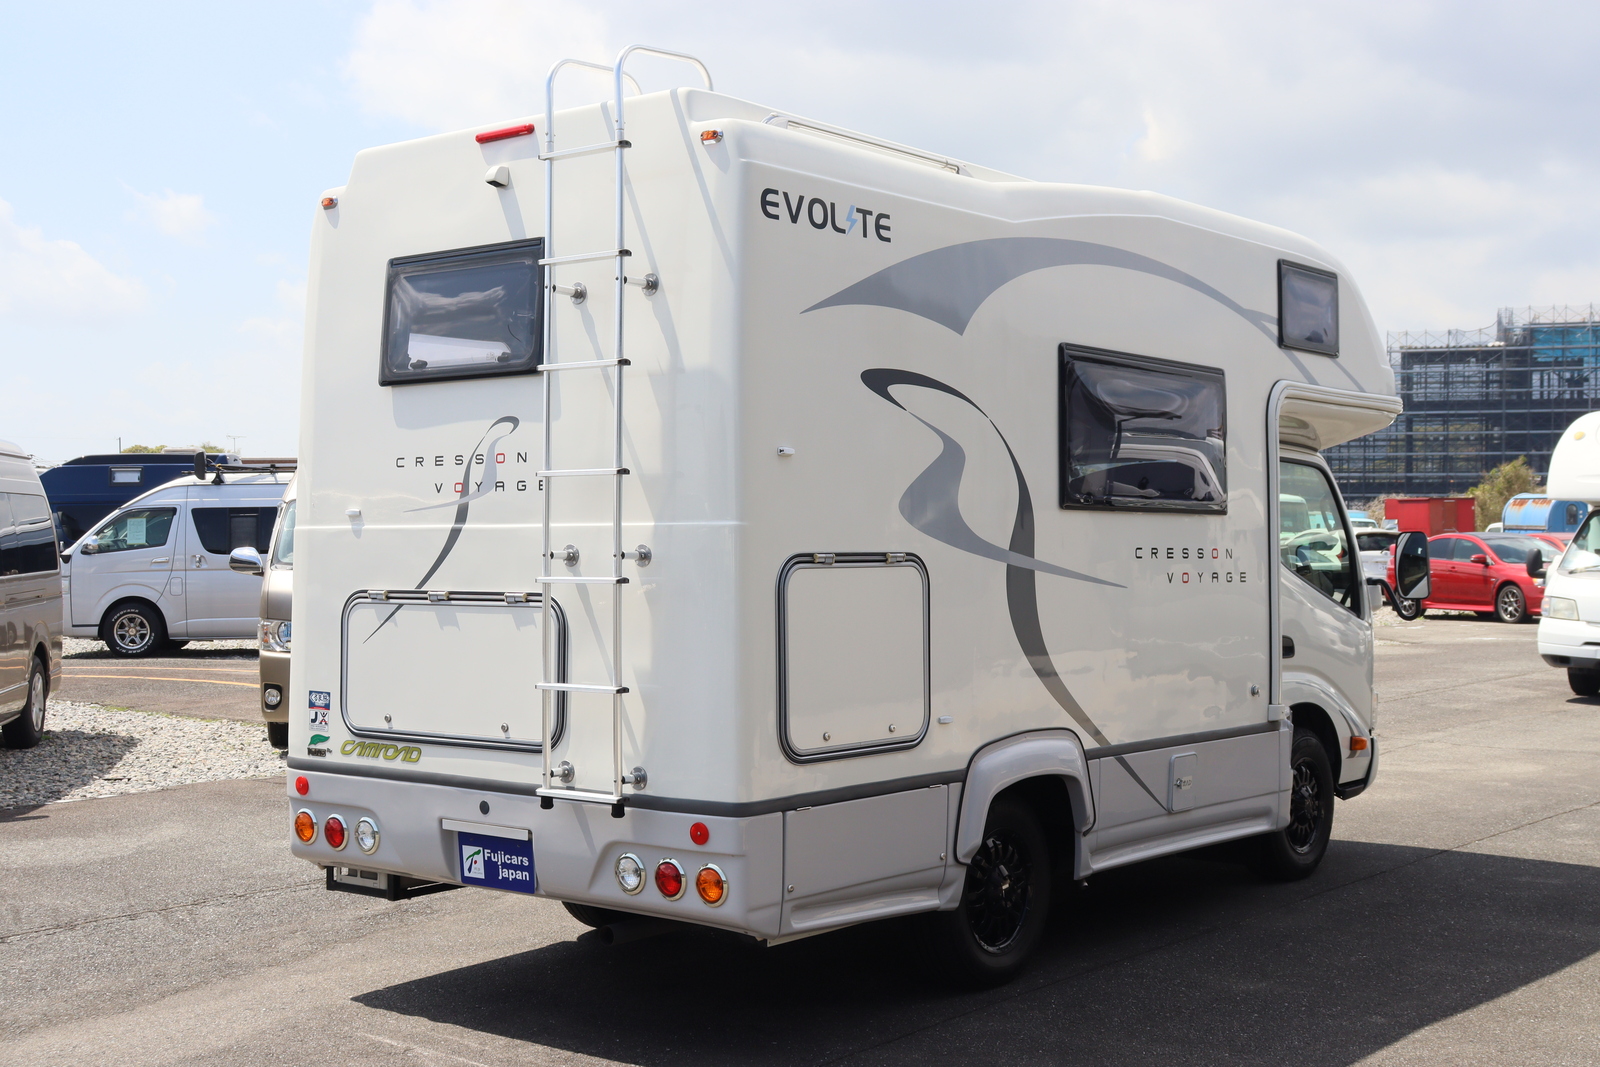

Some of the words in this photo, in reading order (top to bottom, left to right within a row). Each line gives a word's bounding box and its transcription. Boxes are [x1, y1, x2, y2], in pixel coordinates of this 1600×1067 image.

[395, 451, 528, 469] CRESSON
[1134, 547, 1233, 560] CRESSON
[1166, 571, 1247, 584] VOYAGE
[484, 849, 529, 867] Fujicars
[498, 865, 530, 881] japan
